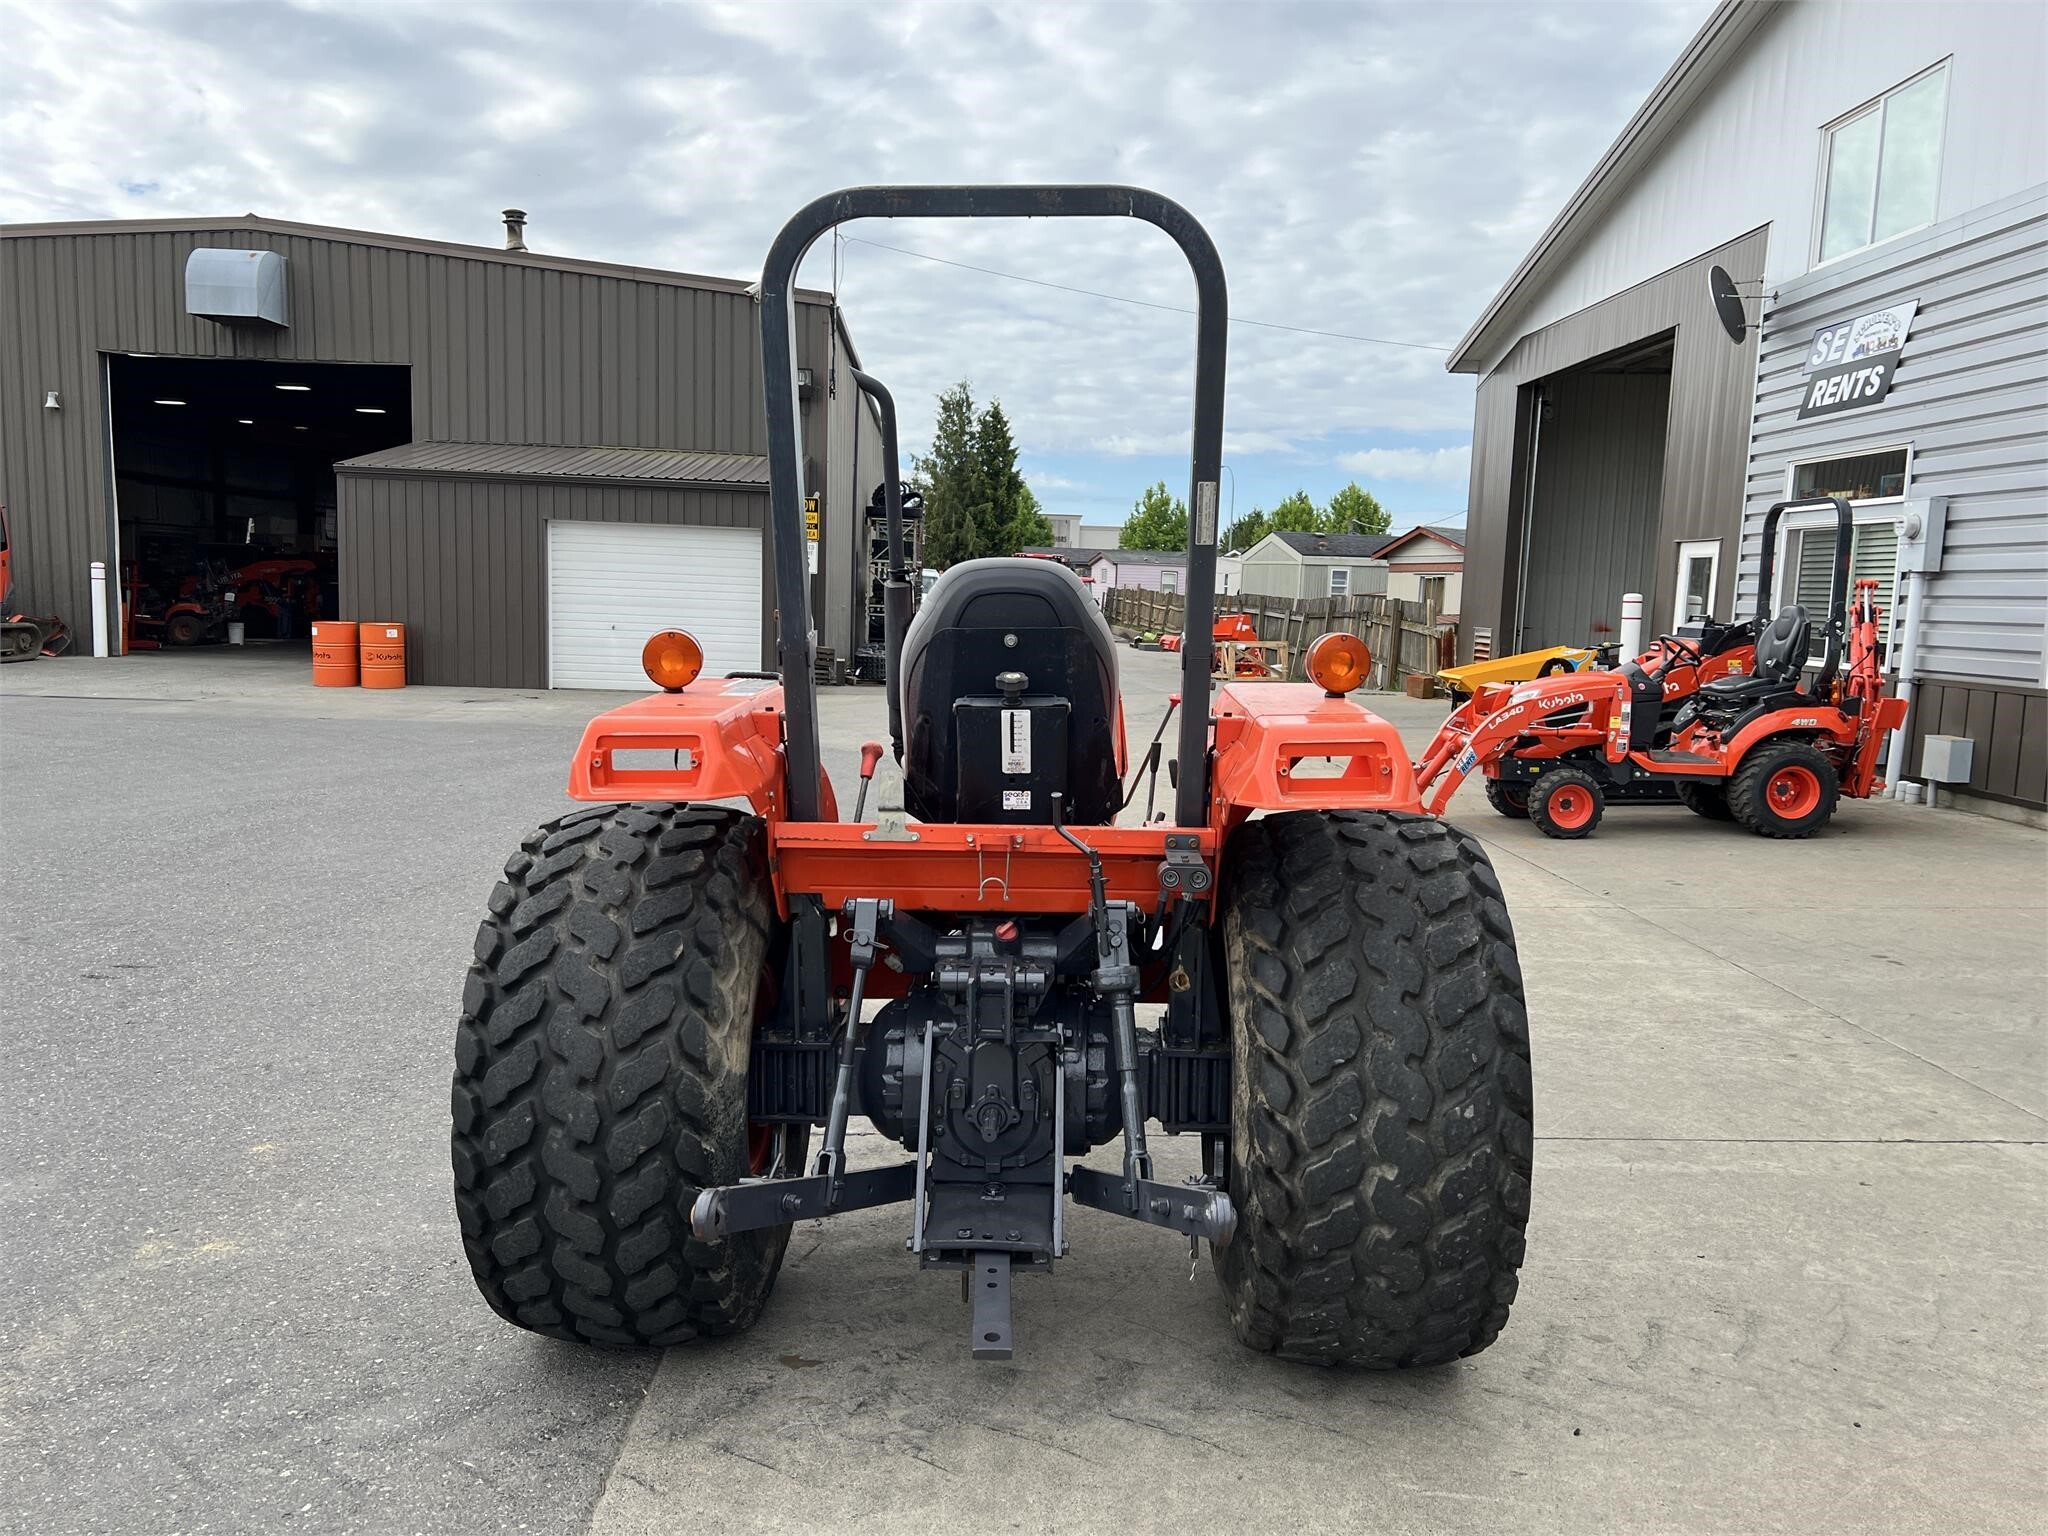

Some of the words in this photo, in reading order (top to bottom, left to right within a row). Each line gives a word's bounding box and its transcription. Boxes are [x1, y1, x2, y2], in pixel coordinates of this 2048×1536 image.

[1811, 326, 1851, 366] SE
[1807, 365, 1885, 409] RENTS
[1663, 681, 1680, 694] ta
[1538, 692, 1584, 709] Kubota
[1488, 705, 1524, 730] LA340
[1791, 718, 1818, 726] 4WD
